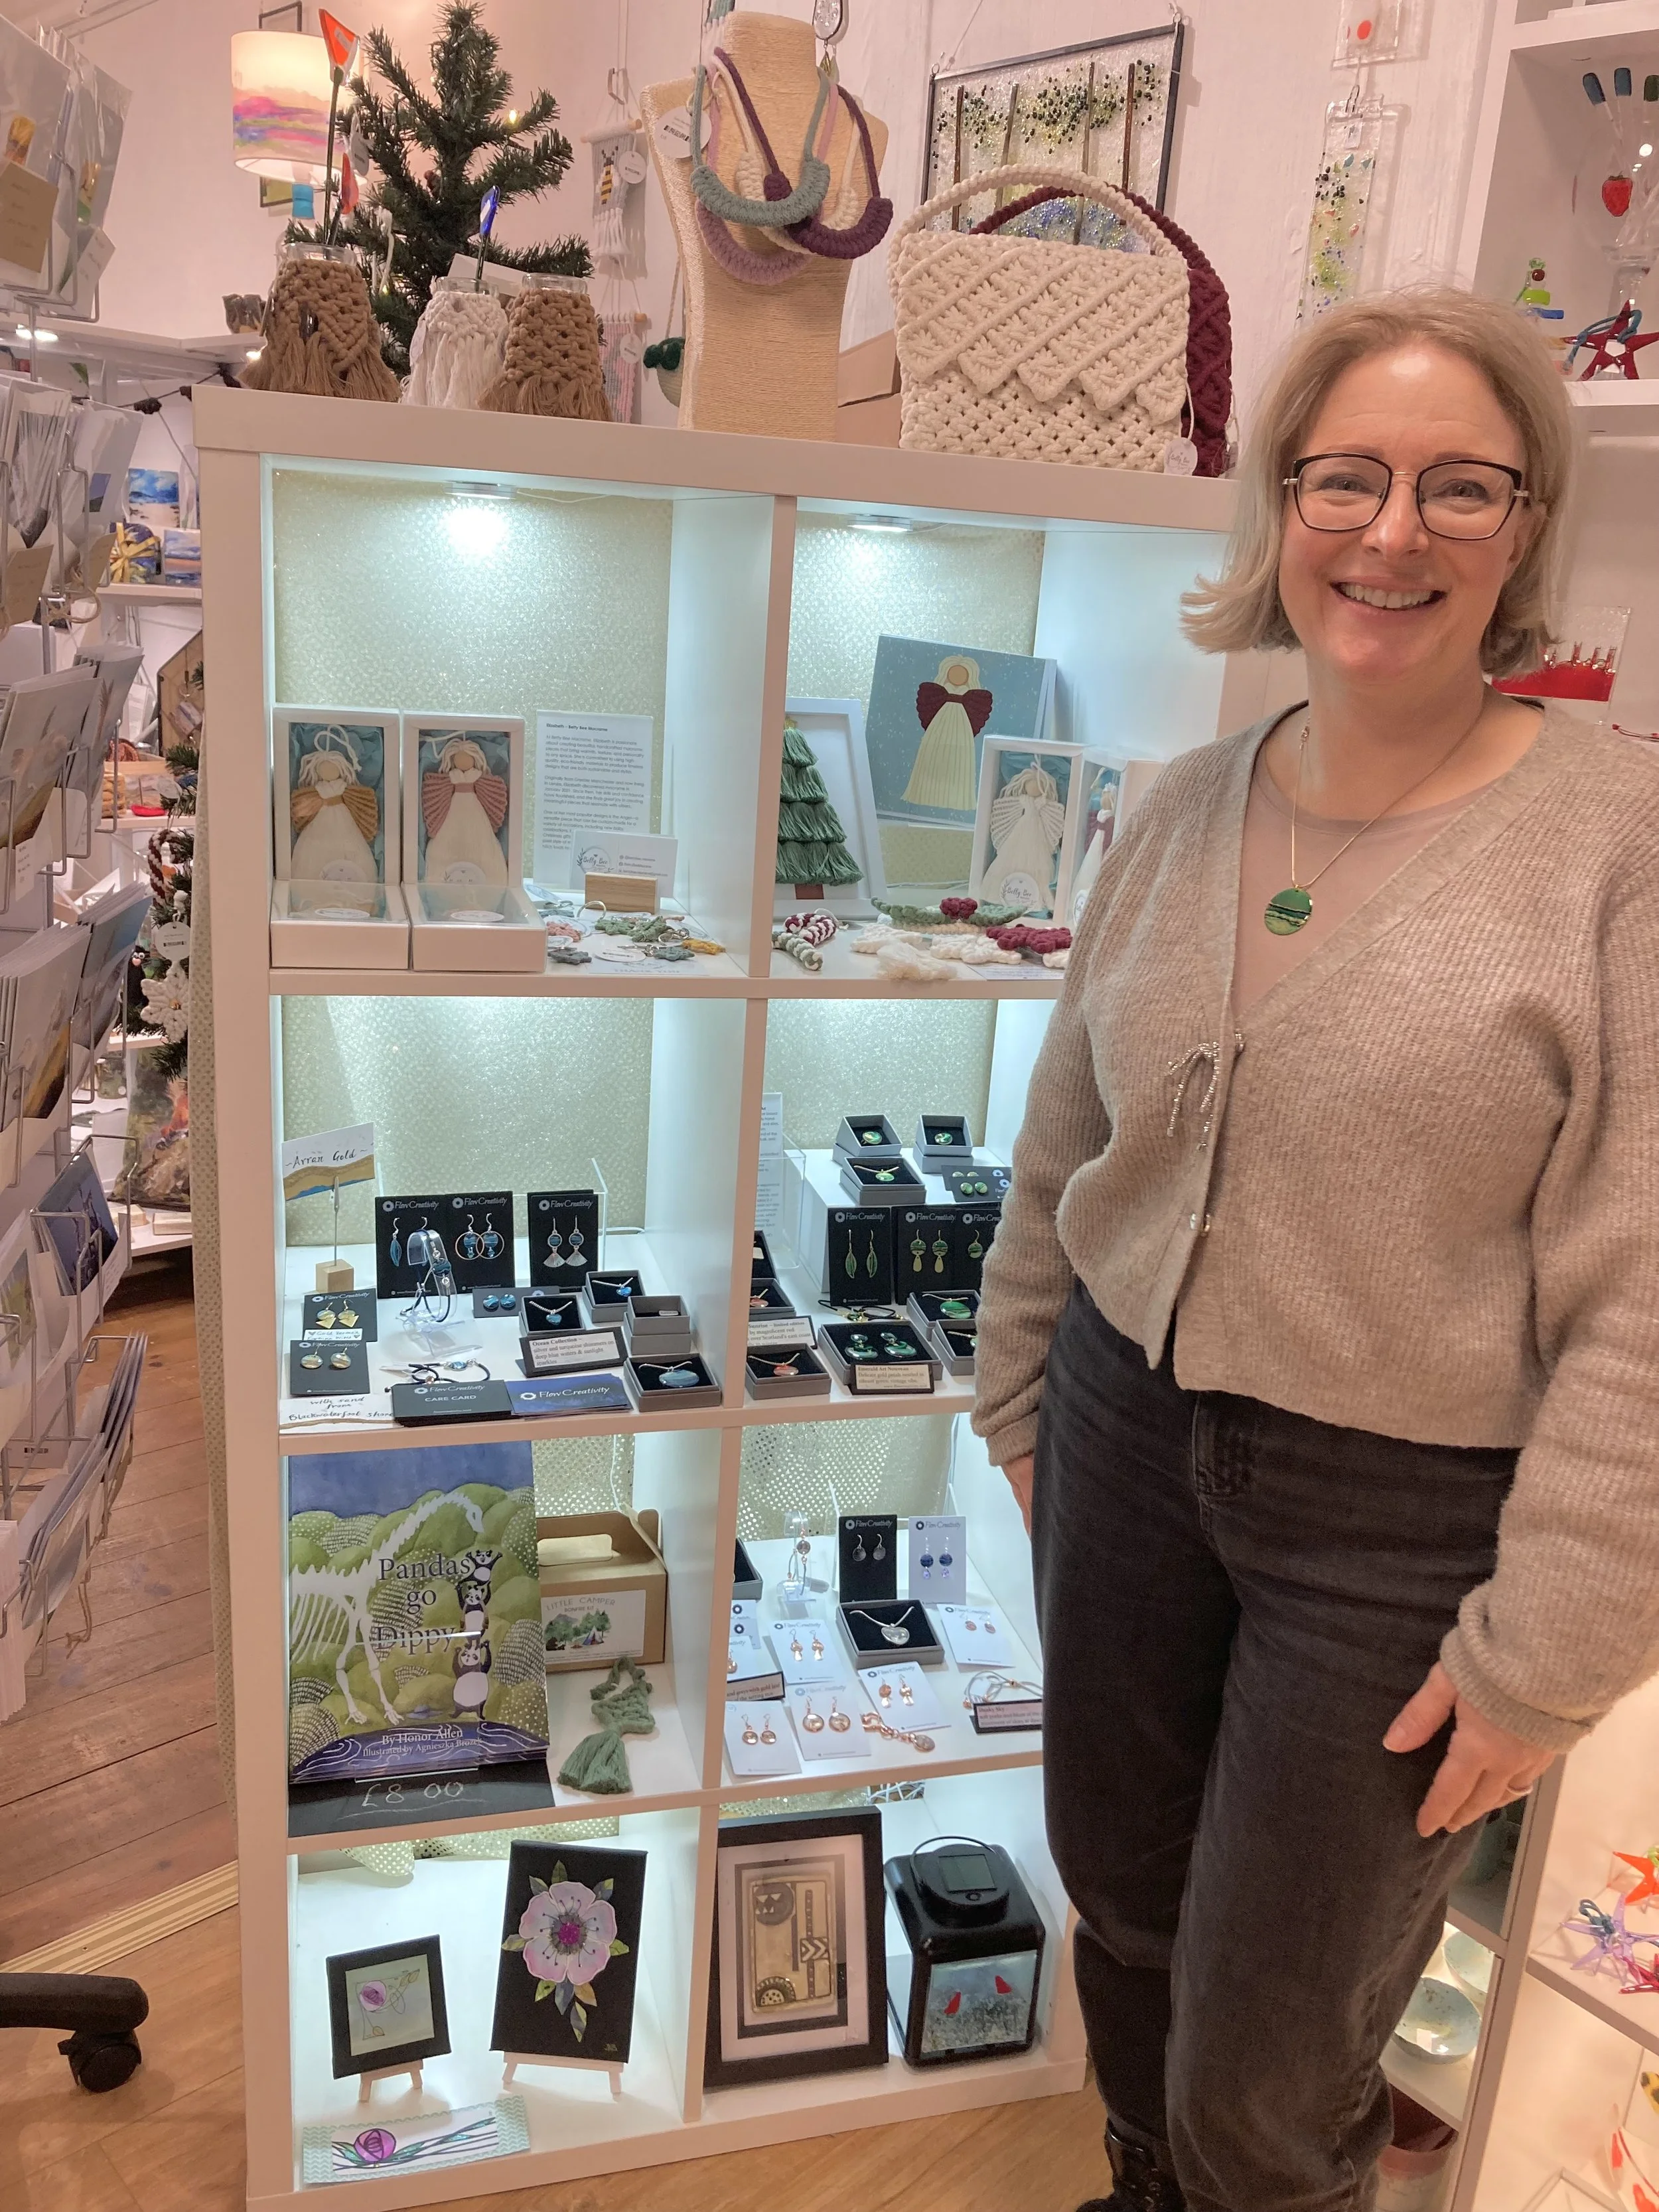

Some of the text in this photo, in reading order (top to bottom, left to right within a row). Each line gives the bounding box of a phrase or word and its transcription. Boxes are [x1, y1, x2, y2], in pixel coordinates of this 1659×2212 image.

[332, 1149, 356, 1162] Gold
[378, 1553, 470, 1580] Pandas
[407, 1589, 437, 1615] go
[547, 1597, 616, 1611] LITTLE CAMPER
[376, 1625, 457, 1655] Dippy
[382, 1728, 463, 1747] By Honor Allen
[363, 1745, 405, 1757] Illustrated
[403, 1745, 413, 1755] by
[415, 1740, 455, 1753] Agnieszka
